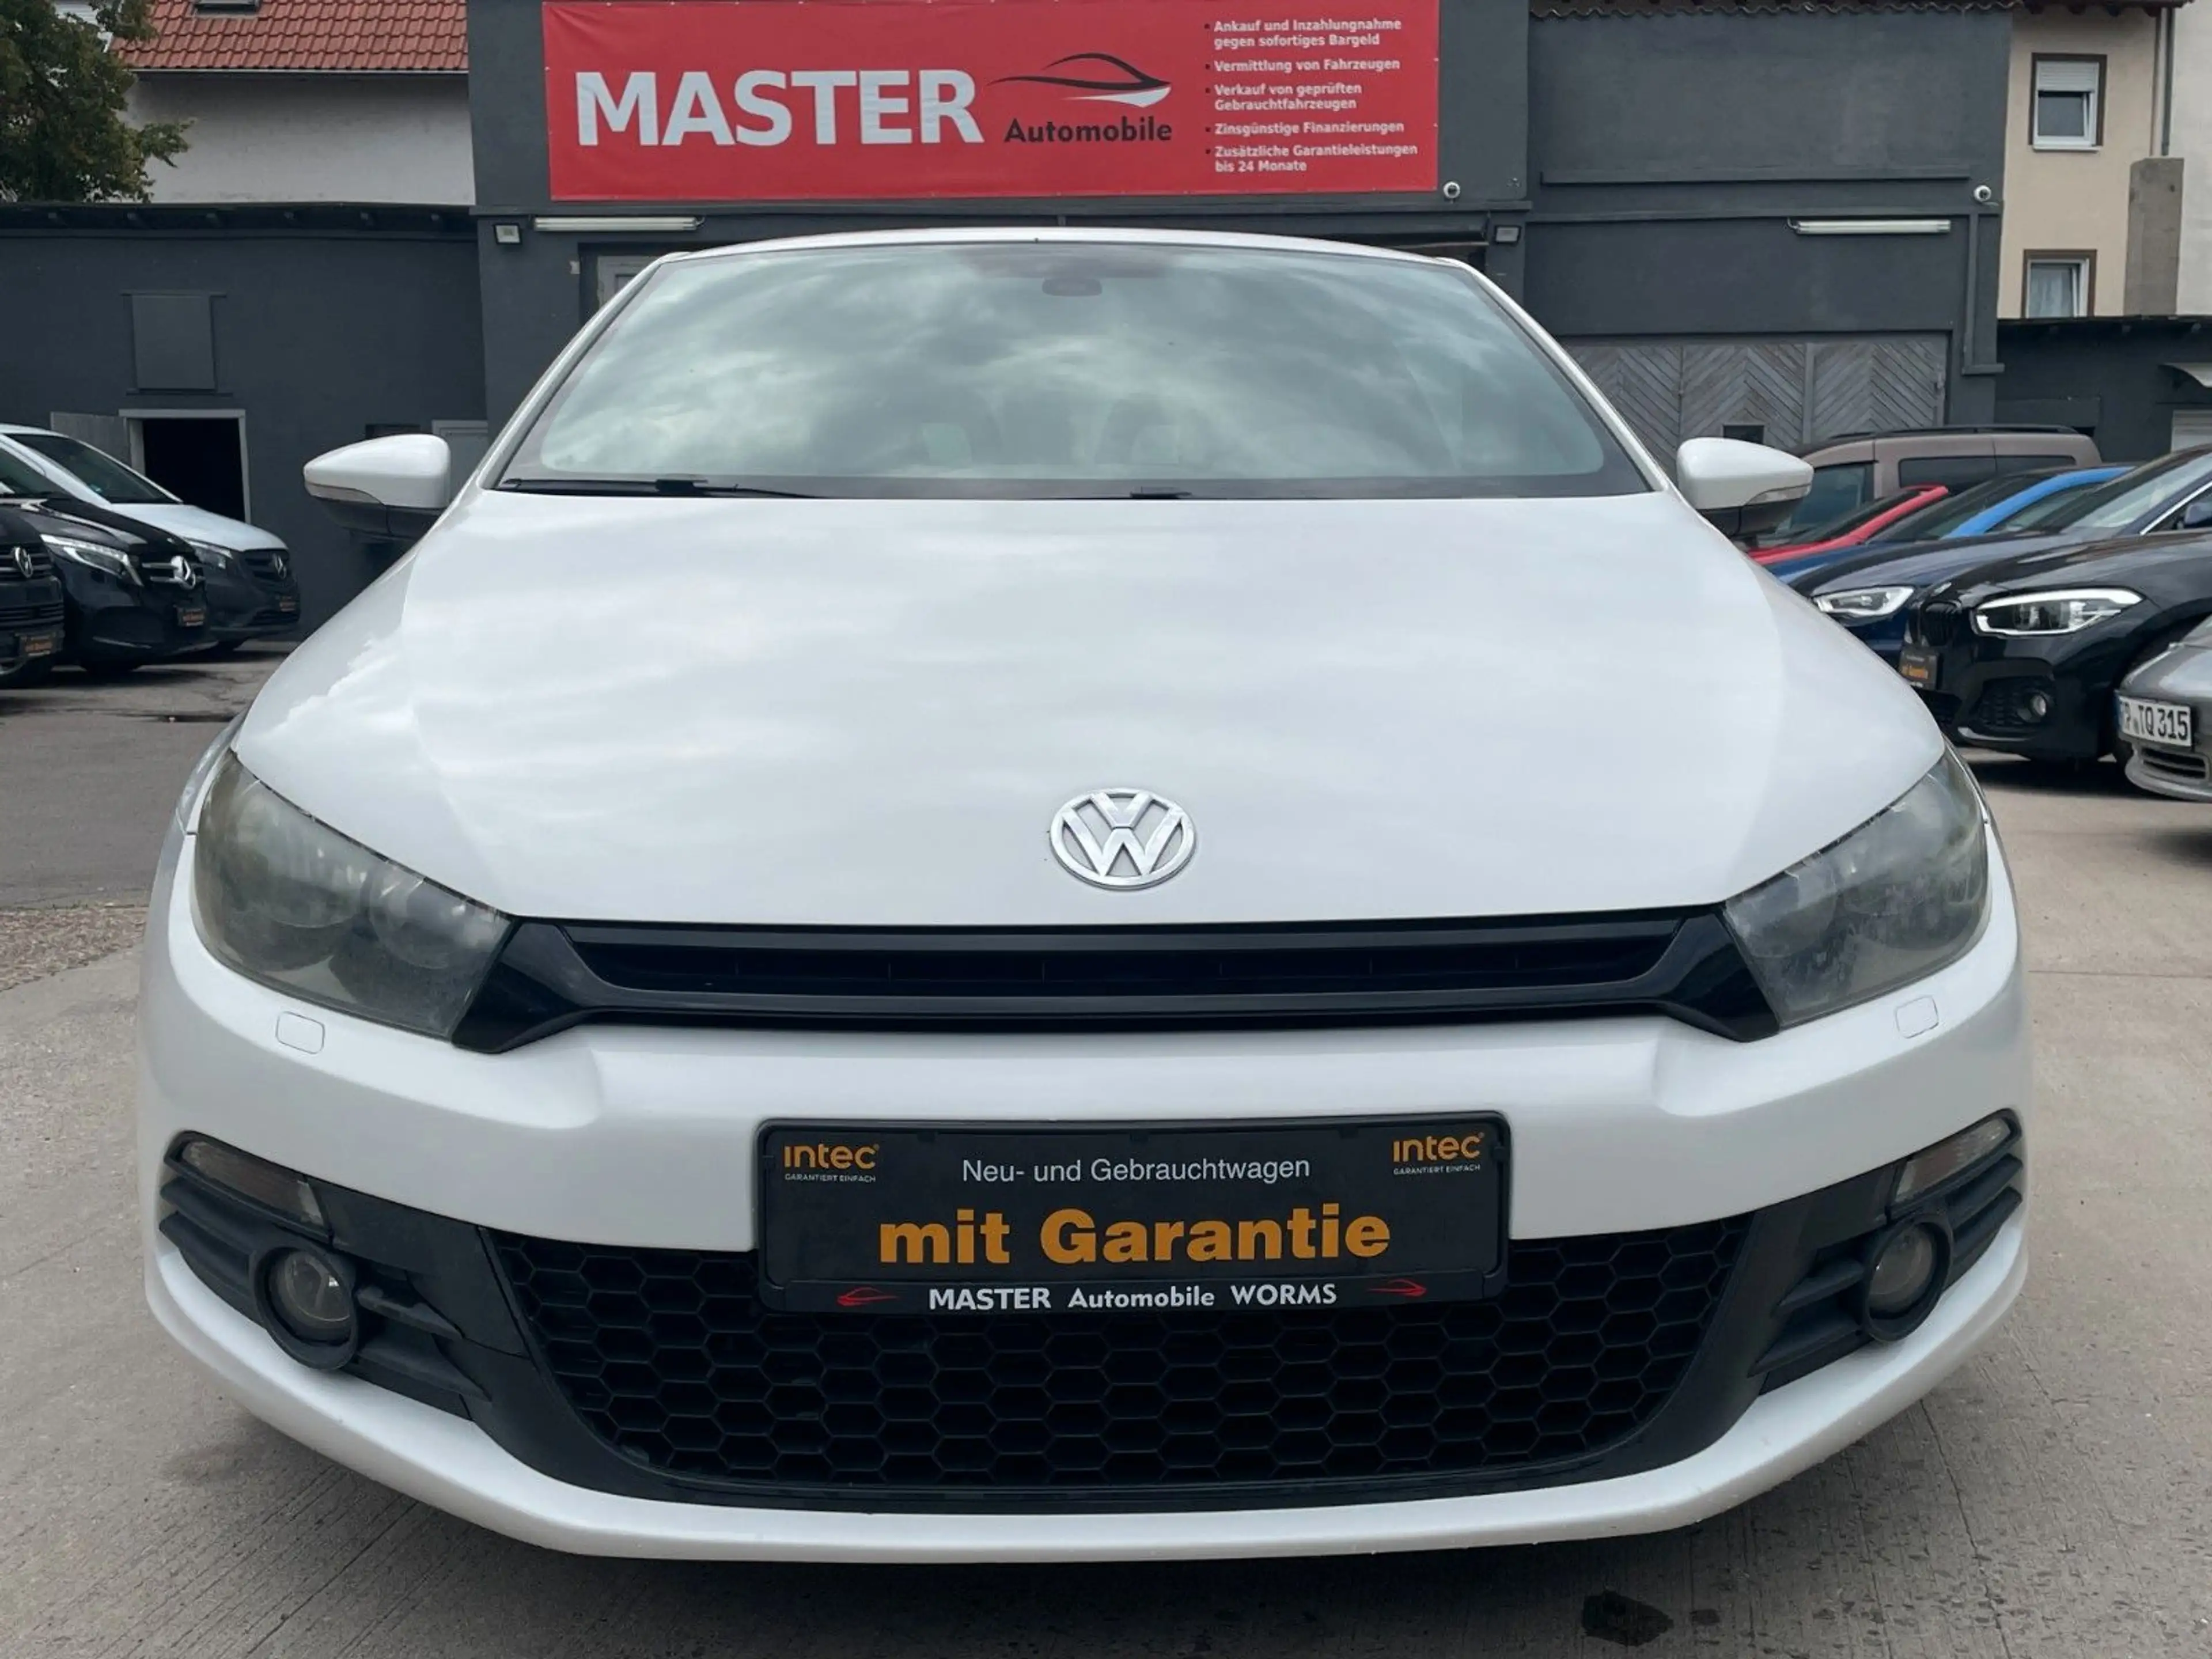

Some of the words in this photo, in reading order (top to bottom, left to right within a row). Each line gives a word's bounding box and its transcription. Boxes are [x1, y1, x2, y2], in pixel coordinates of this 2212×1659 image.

[1214, 20, 1262, 32] Ankauf
[1264, 18, 1290, 31] und
[1293, 17, 1402, 33] Inzahlungnahme
[1214, 37, 1256, 50] gegen
[1258, 34, 1325, 48] sofortiges
[1328, 33, 1380, 47] Bargeld
[1214, 59, 1292, 74] Vermittlung
[1296, 60, 1320, 70] von
[1323, 58, 1401, 72] Fahrzeugen
[1214, 82, 1267, 96] Verkauf
[1268, 85, 1293, 94] von
[1296, 81, 1362, 97] geprüften
[576, 69, 984, 146] MASTER
[1214, 97, 1357, 112] Gebrauchtfahrzeugen
[1004, 115, 1173, 143] Automobile
[1214, 122, 1300, 138] Zinsgünstige
[1303, 120, 1404, 135] Finanzierungen
[1214, 144, 1290, 157] Zusätzliche
[1293, 143, 1418, 158] Garantieleistungen
[1214, 160, 1235, 172] bis
[1237, 160, 1255, 172] 24
[1258, 160, 1307, 172] Monate
[2157, 707, 2188, 741] 315
[1055, 789, 1191, 885] VW
[963, 1159, 1025, 1182] Neu-
[1033, 1160, 1081, 1182] und
[1090, 1157, 1310, 1184] Gebrauchtwagen
[880, 1209, 1010, 1264] mit
[1040, 1203, 1391, 1264] Garantie
[929, 1287, 1051, 1311] MASTER
[1067, 1285, 1215, 1309] Automobile
[1230, 1283, 1337, 1306] WORMS
